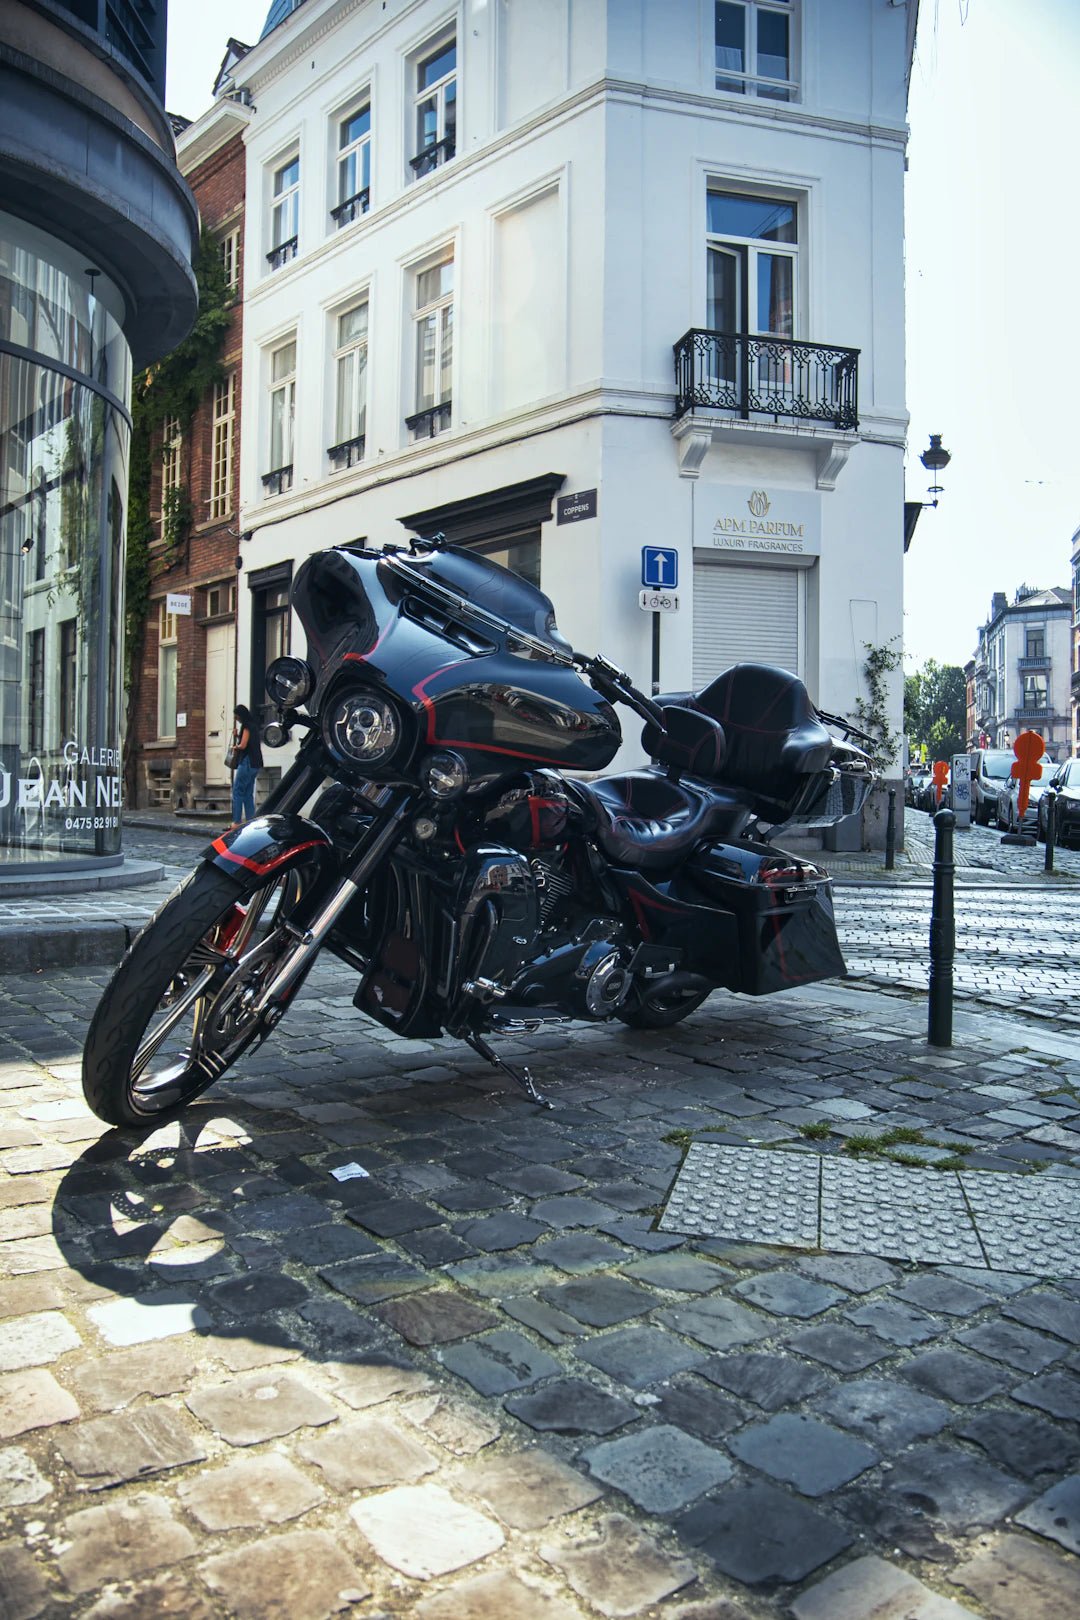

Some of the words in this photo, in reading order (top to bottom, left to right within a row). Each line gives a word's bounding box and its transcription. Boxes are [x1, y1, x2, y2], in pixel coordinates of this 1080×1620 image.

[563, 503, 589, 516] COPPENS
[713, 518, 747, 533] APM
[749, 520, 804, 537] PARFUM
[713, 538, 745, 548] LUXURY
[748, 540, 804, 552] FRAGRANCES
[64, 741, 119, 767] GALERIE
[65, 817, 92, 830] 0475
[93, 816, 104, 829] 82
